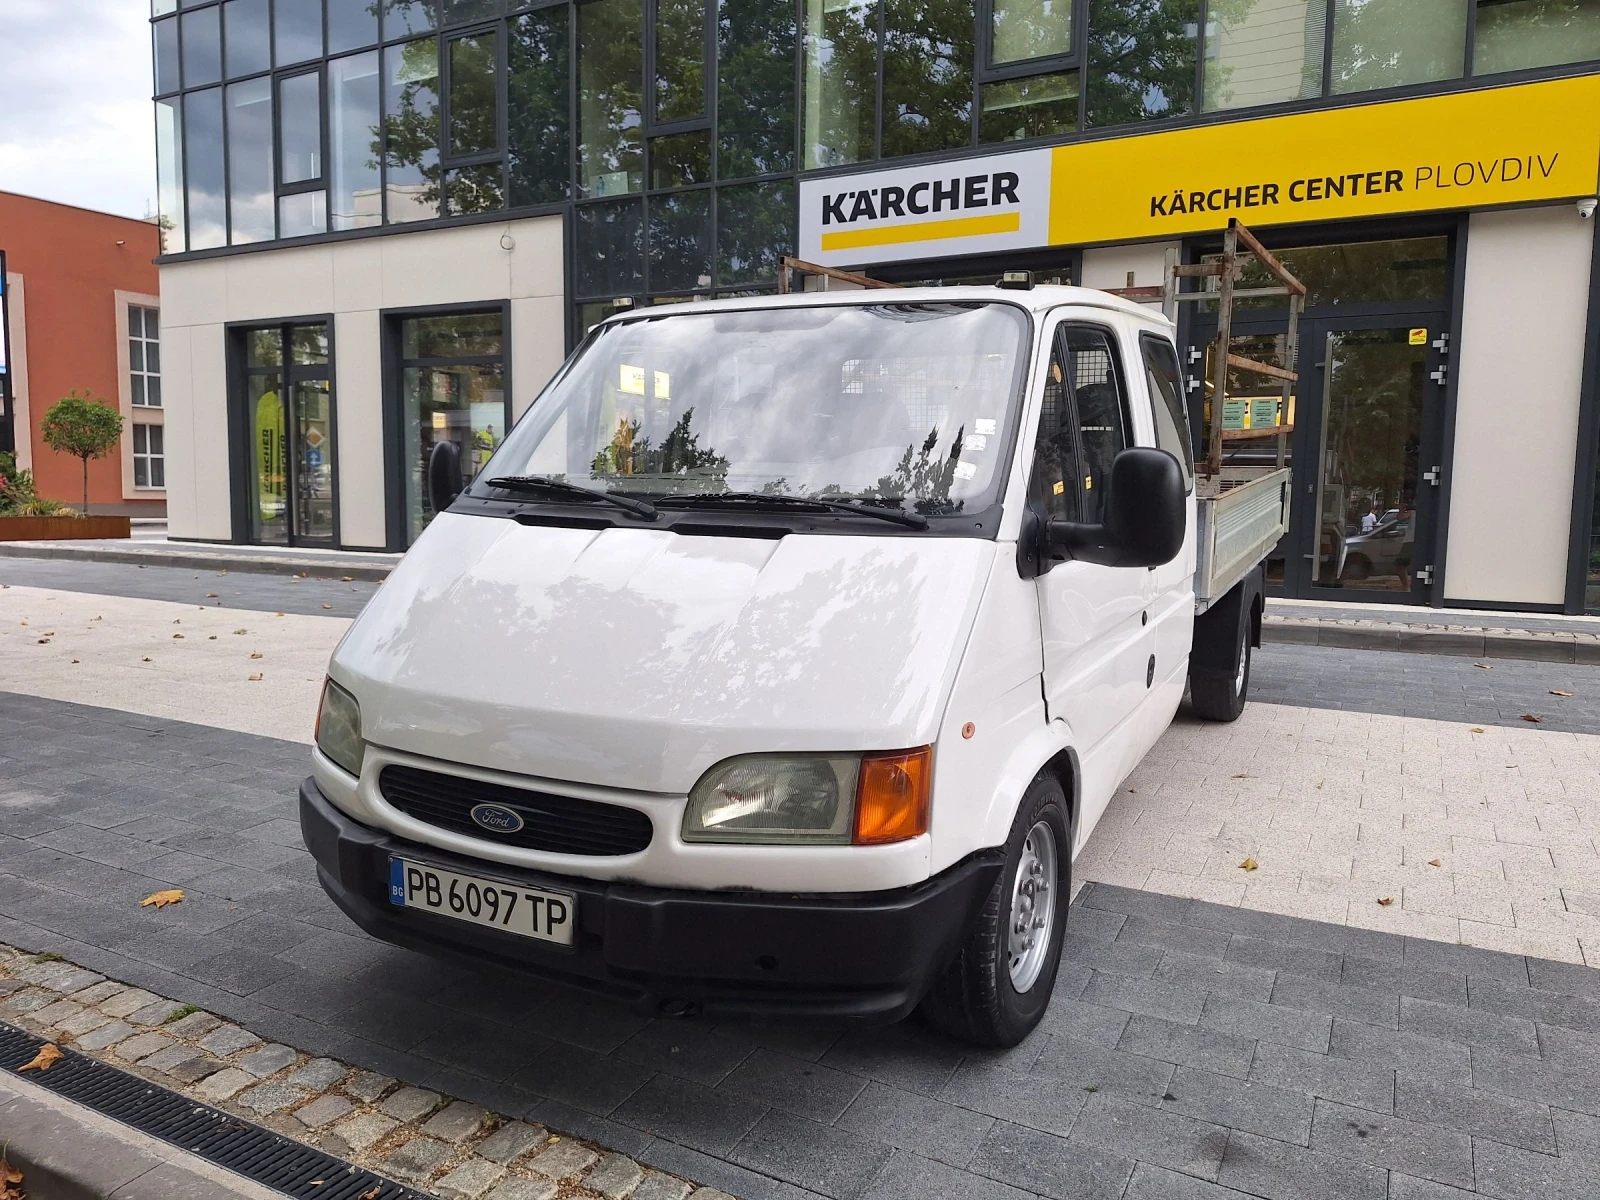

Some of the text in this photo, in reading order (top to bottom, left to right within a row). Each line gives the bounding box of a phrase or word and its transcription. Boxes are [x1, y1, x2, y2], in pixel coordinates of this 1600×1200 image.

[822, 171, 1020, 225] KÄRCHER
[1150, 152, 1559, 217] KÄRCHER CENTER PLOVDIV
[481, 808, 510, 828] Ford
[392, 885, 404, 897] BG
[407, 867, 567, 936] PB 6097 TP
